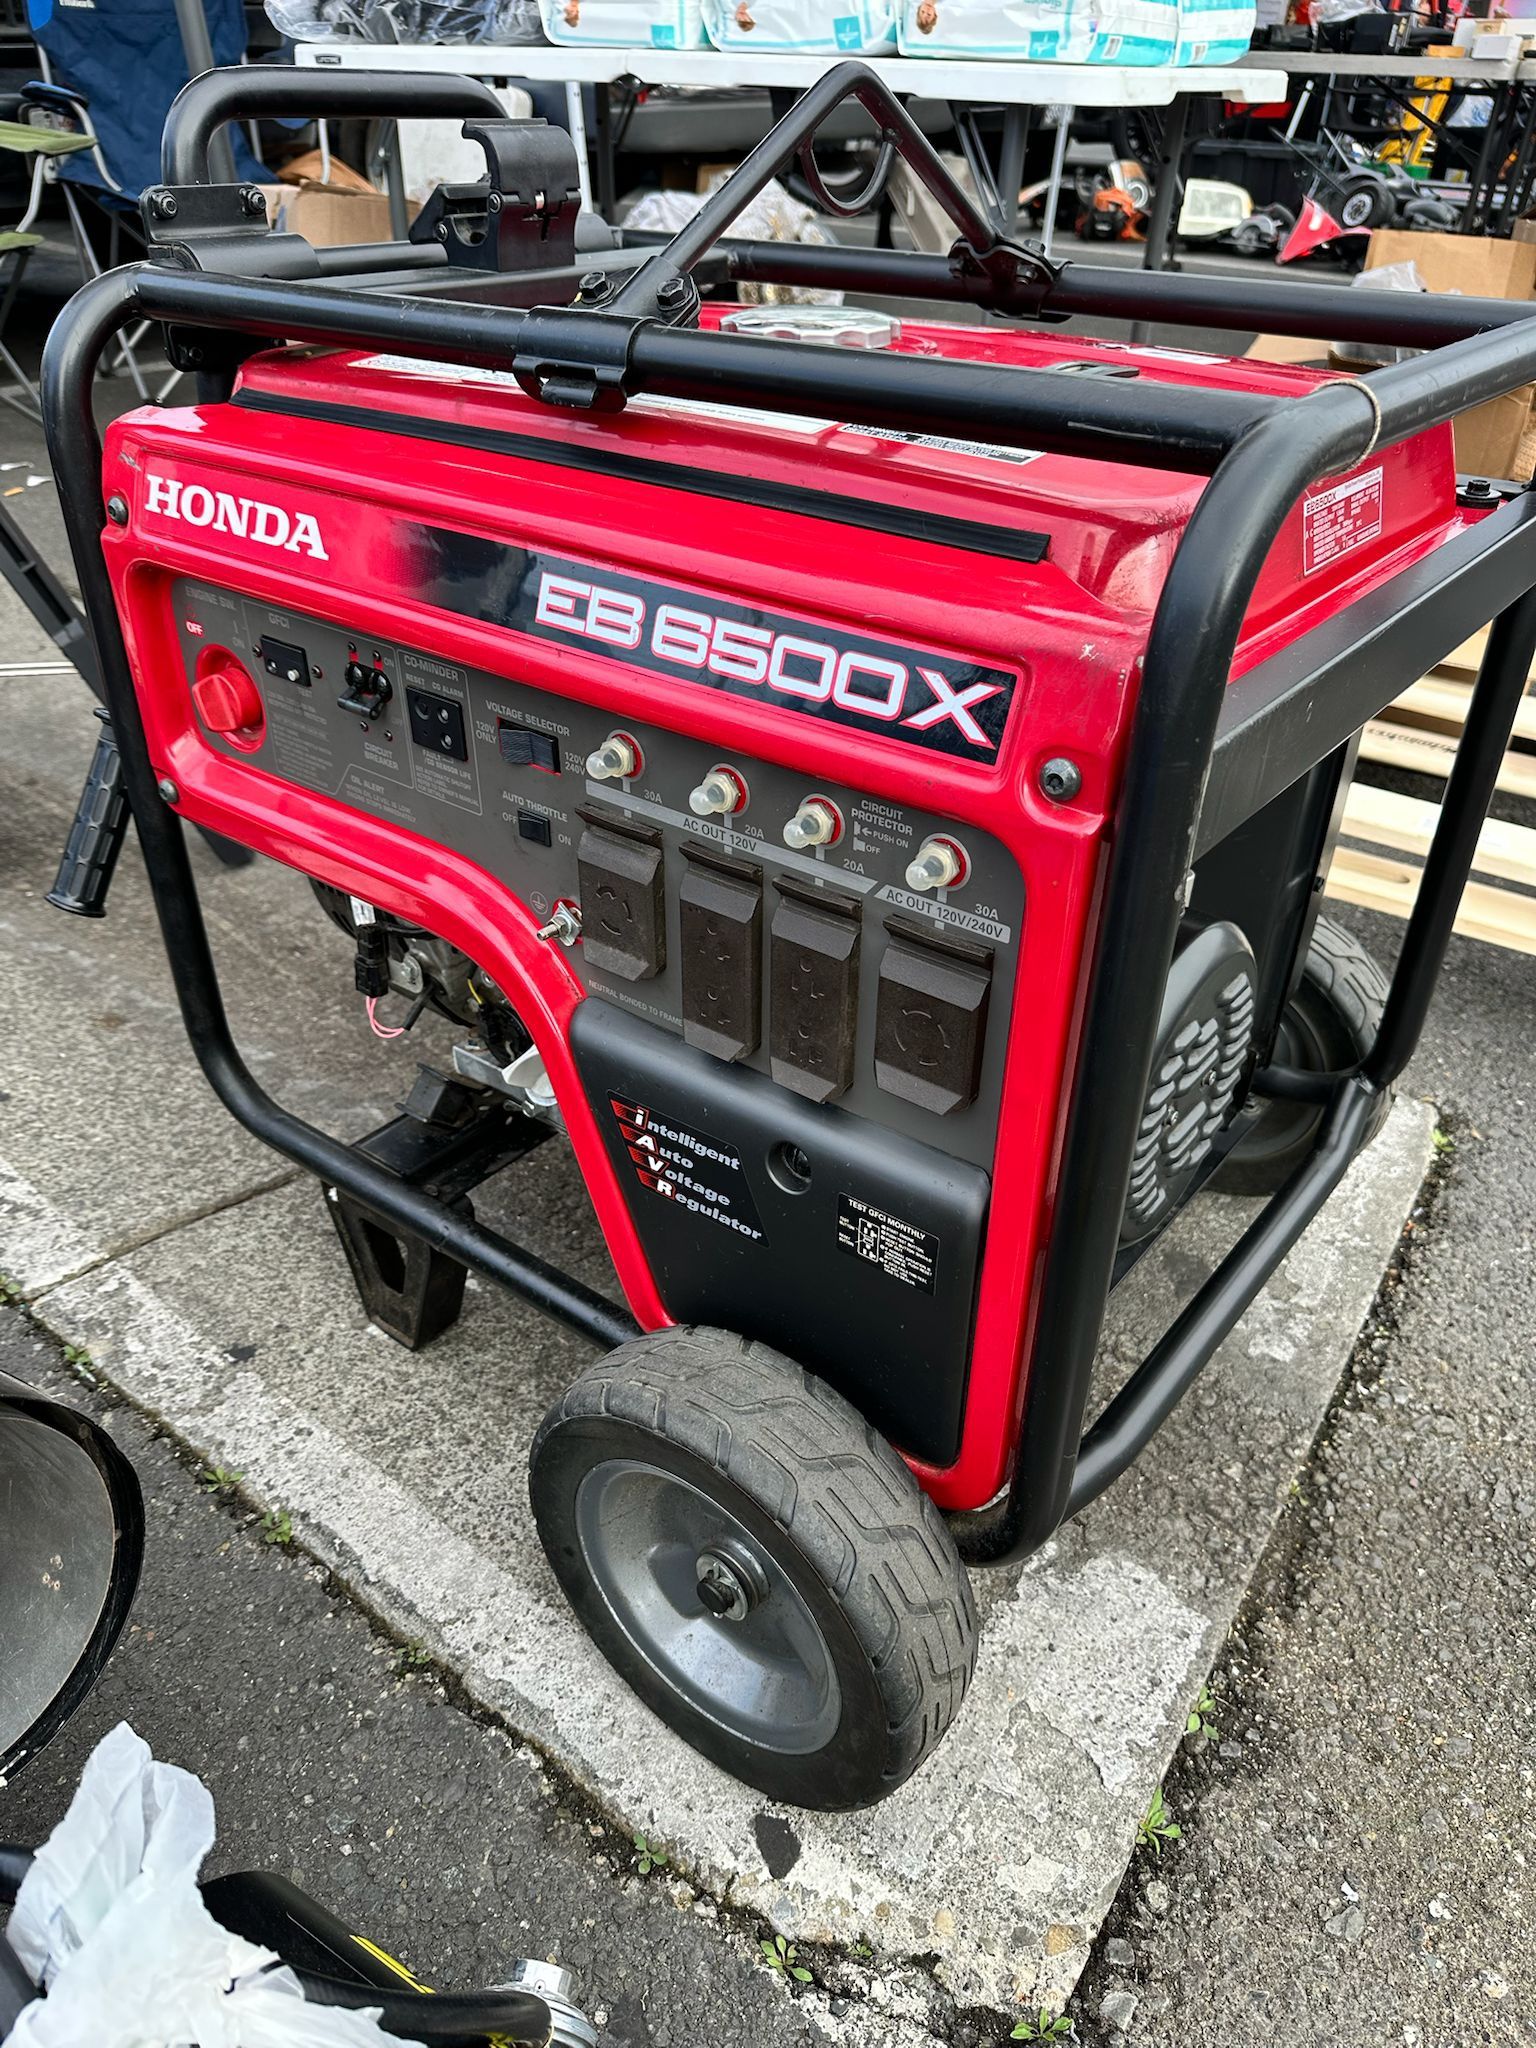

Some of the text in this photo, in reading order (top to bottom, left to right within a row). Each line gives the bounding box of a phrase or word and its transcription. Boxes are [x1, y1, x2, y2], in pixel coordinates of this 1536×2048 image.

[144, 474, 329, 561] HONDA
[185, 586, 218, 605] ENGINE
[186, 621, 203, 636] OFF
[269, 613, 290, 629] GFCI
[404, 654, 459, 682] CO-MINDER
[406, 672, 424, 686] RESET
[442, 685, 464, 698] ALARM
[486, 700, 570, 736] VOLTAGE SELECTOR
[476, 720, 495, 734] 120V
[476, 730, 497, 744] ONLY
[364, 742, 393, 759] CIRCUIT
[564, 752, 586, 765] 120V
[364, 750, 399, 770] BREAKER
[565, 761, 586, 776] 240V
[364, 780, 384, 794] ALERT
[644, 789, 663, 804] 30A
[502, 790, 568, 822] AUTO THROTTLE
[861, 800, 903, 821] CIRCUIT
[502, 812, 518, 824] OFF
[851, 808, 913, 836] PROTECTOR
[558, 834, 572, 846] ON
[683, 818, 757, 852] AC OUT 120V
[744, 824, 764, 840] 20A
[872, 830, 909, 848] PUSH ON
[866, 844, 880, 854] OFF
[843, 858, 864, 874] 20A
[886, 890, 1002, 938] AC OUT 120V/240V
[974, 904, 998, 920] 30A
[588, 980, 683, 1027] NEUTRAL BONDED TO FRAME
[635, 1109, 741, 1170] intelligent
[635, 1134, 694, 1169] Auto
[648, 1156, 731, 1206] Voltage
[657, 1179, 762, 1239] Regulator
[848, 1199, 926, 1240] TEST GFCI MONTHLY
